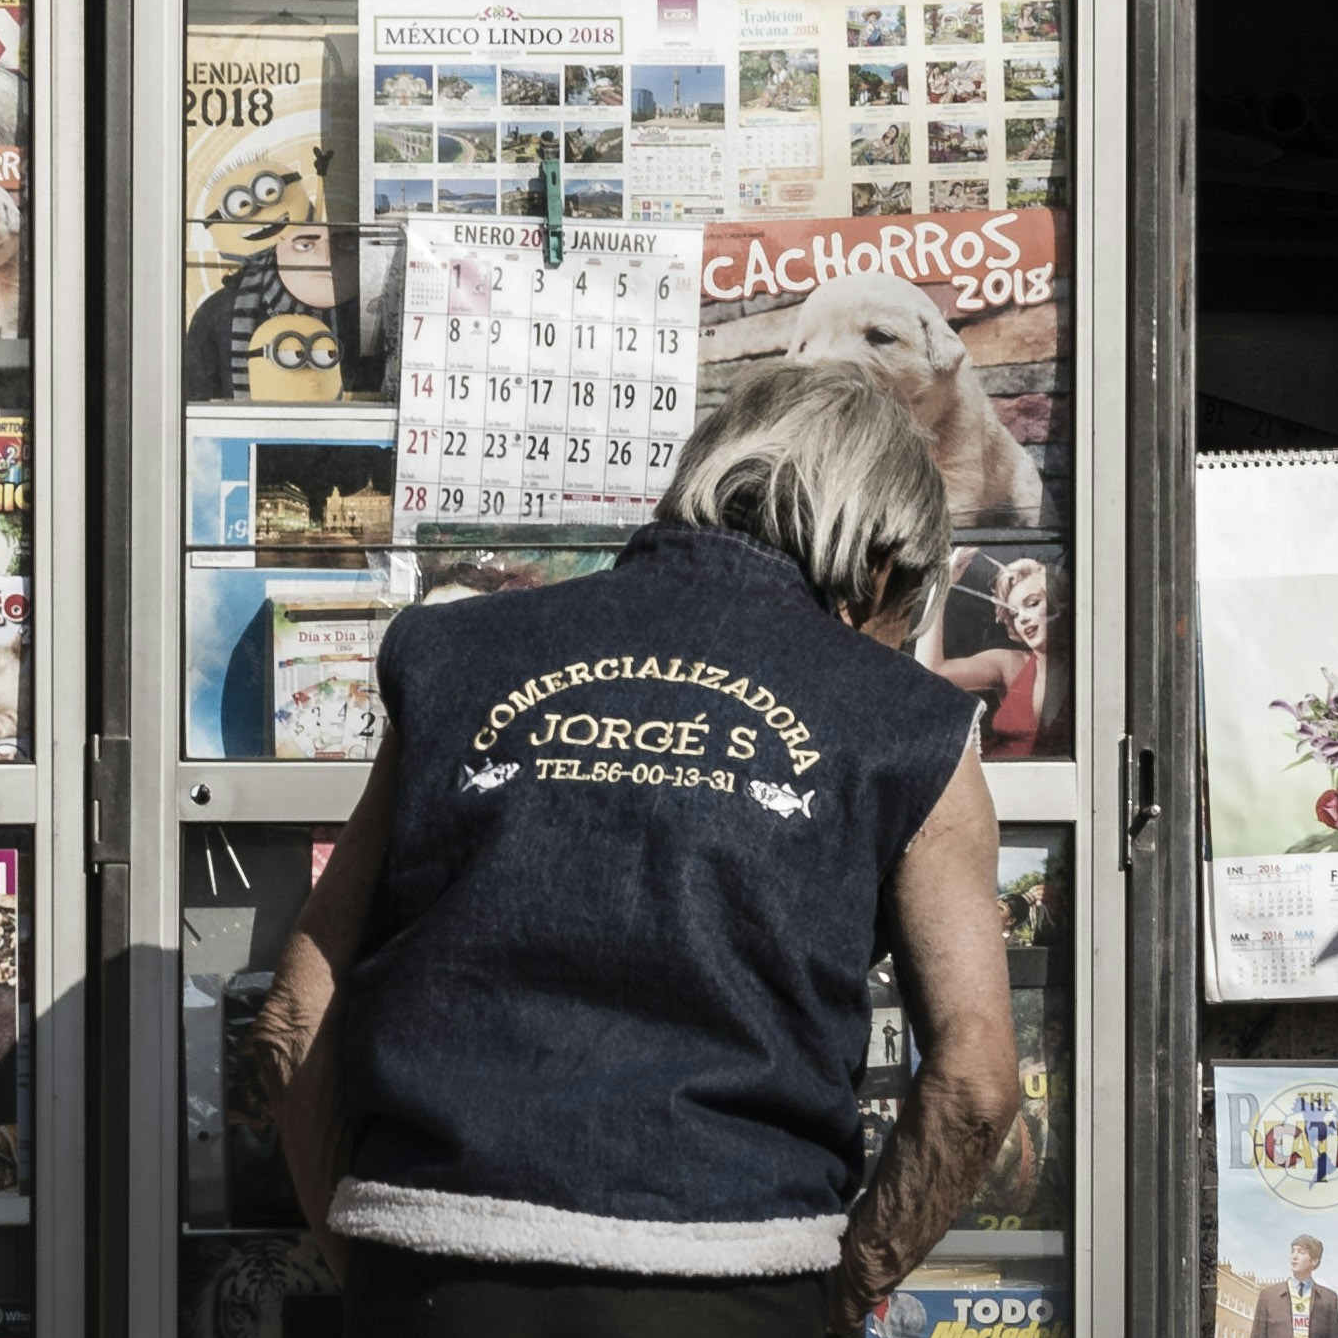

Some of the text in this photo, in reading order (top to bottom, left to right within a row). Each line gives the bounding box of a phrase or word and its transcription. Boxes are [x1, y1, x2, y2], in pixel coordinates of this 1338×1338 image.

[385, 23, 614, 45] MÉXICO LINDO 2018
[740, 23, 818, 36] exicana 2018
[184, 88, 273, 127] 2018
[454, 224, 657, 253] ENERO JANUARY
[703, 212, 1021, 299] CACHORROS
[952, 262, 1053, 310] 2018
[413, 316, 678, 354] 7 8 9 10 11 12 13
[403, 486, 545, 518] 28 29 30 31
[299, 631, 356, 643] Día x Día
[473, 657, 821, 776] COMERCIALIZADORA
[727, 726, 758, 760] S
[536, 759, 735, 793] TEL.56-00-13-31
[1297, 1092, 1332, 1111] THE
[953, 1298, 1053, 1324] TODO
